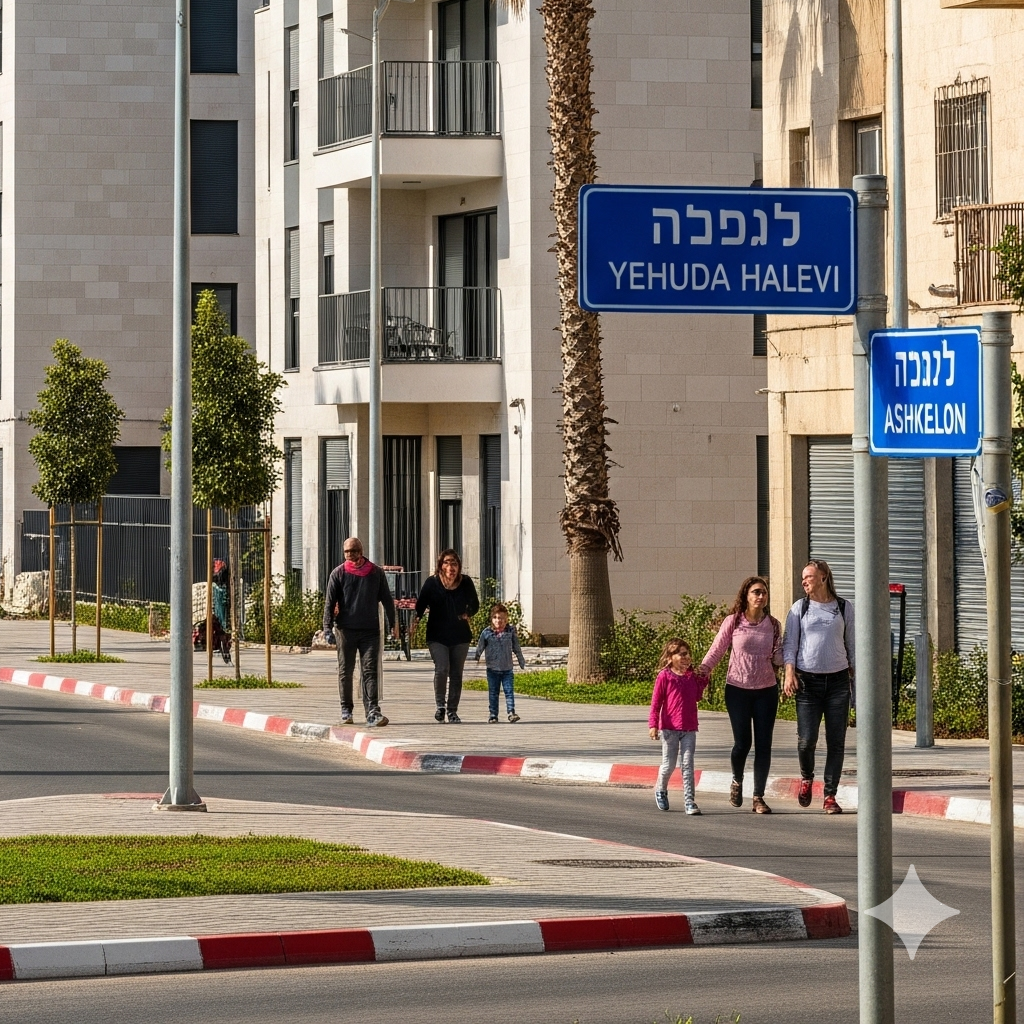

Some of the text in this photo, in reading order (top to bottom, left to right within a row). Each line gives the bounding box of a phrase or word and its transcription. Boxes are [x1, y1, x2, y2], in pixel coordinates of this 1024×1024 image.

[608, 261, 839, 293] YEHUDA HALEVI
[884, 402, 966, 435] ASHKELON
